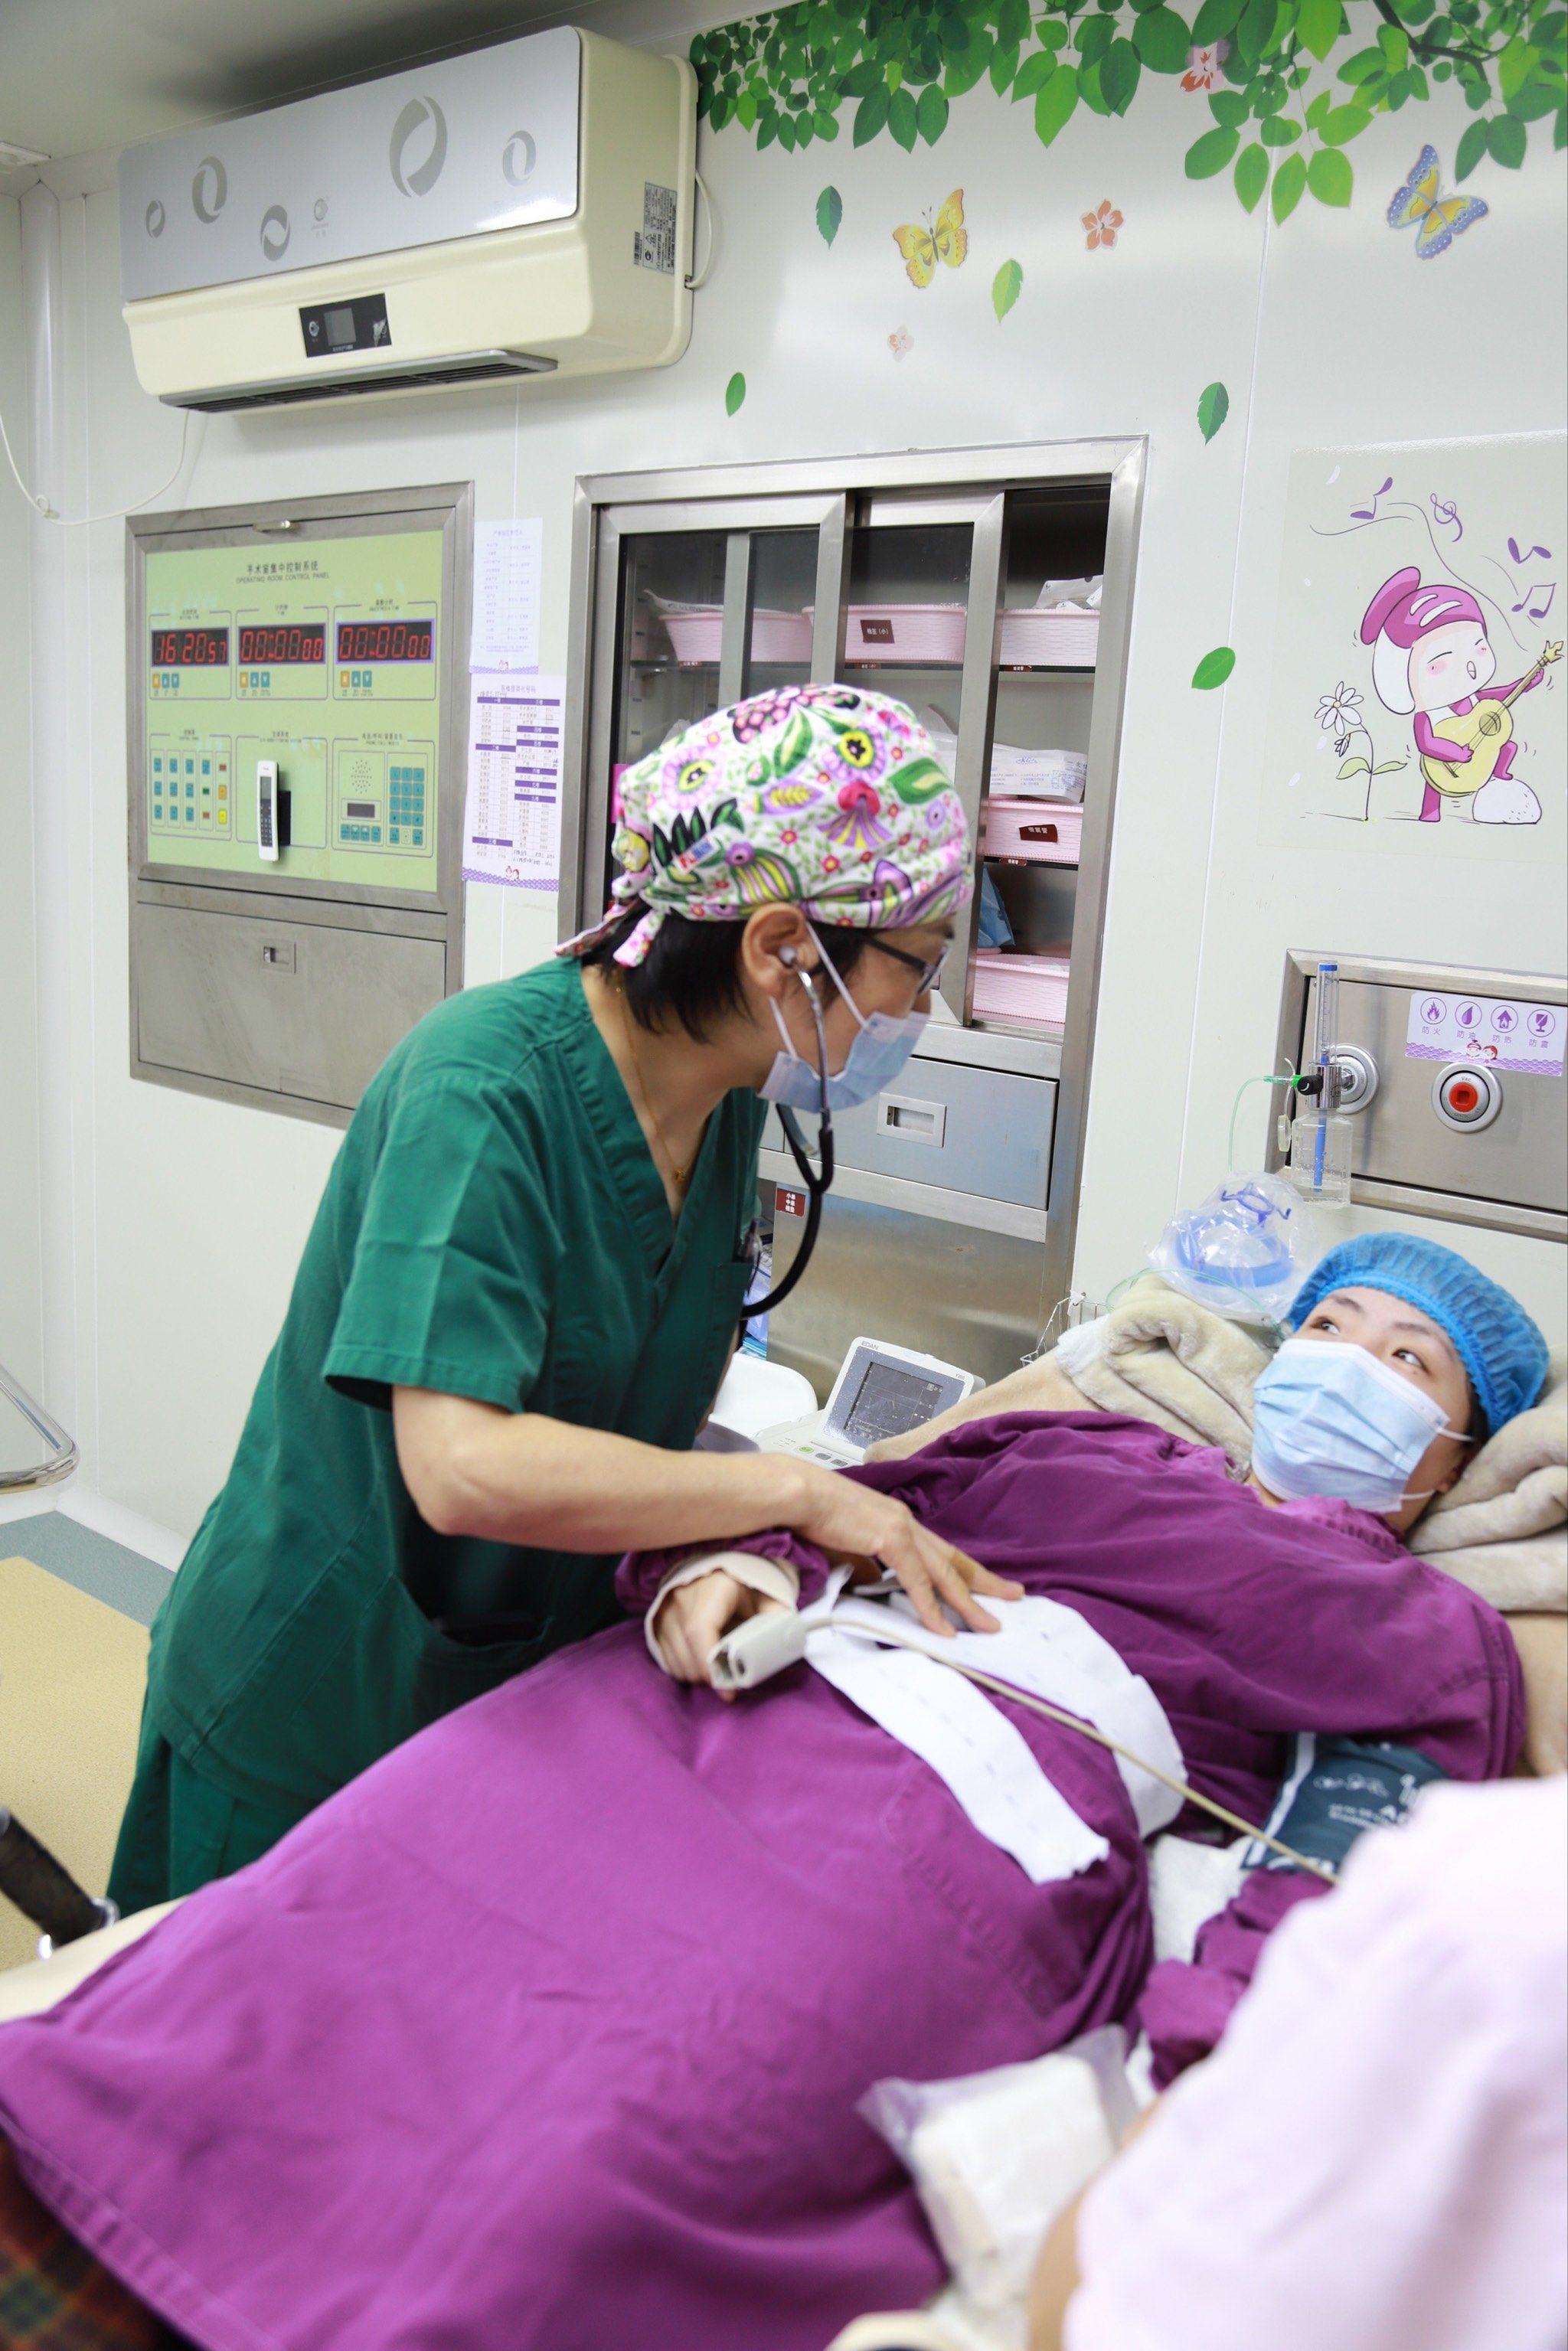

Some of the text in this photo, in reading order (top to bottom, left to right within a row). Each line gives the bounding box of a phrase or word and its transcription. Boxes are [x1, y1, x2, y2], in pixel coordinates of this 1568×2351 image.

[284, 572, 309, 581] CONTROL
[312, 571, 329, 580] PANEL
[1422, 1026, 1441, 1035] 防火
[1528, 1039, 1550, 1049] 防震
[861, 1340, 880, 1350] EDAN
